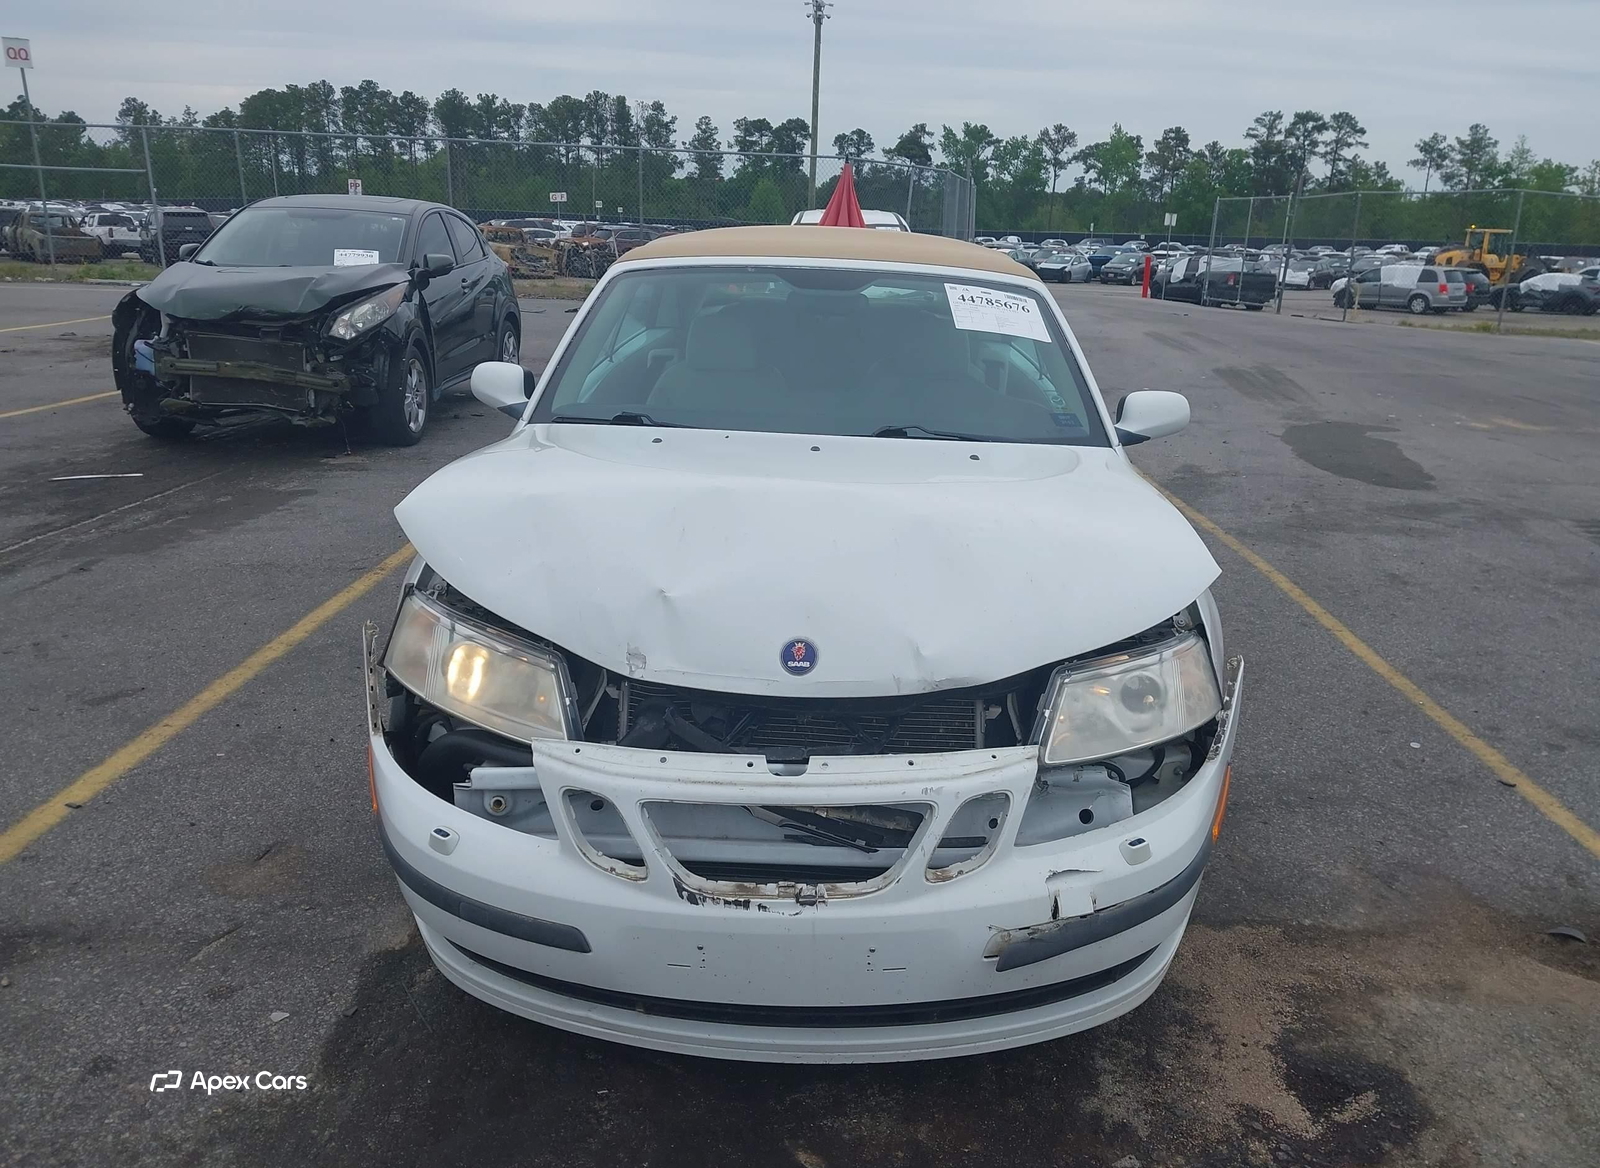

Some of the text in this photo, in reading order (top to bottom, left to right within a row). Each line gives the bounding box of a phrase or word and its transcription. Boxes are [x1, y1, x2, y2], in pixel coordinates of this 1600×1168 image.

[6, 46, 30, 61] QQ
[551, 193, 566, 201] G F
[957, 293, 1031, 314] 44785676
